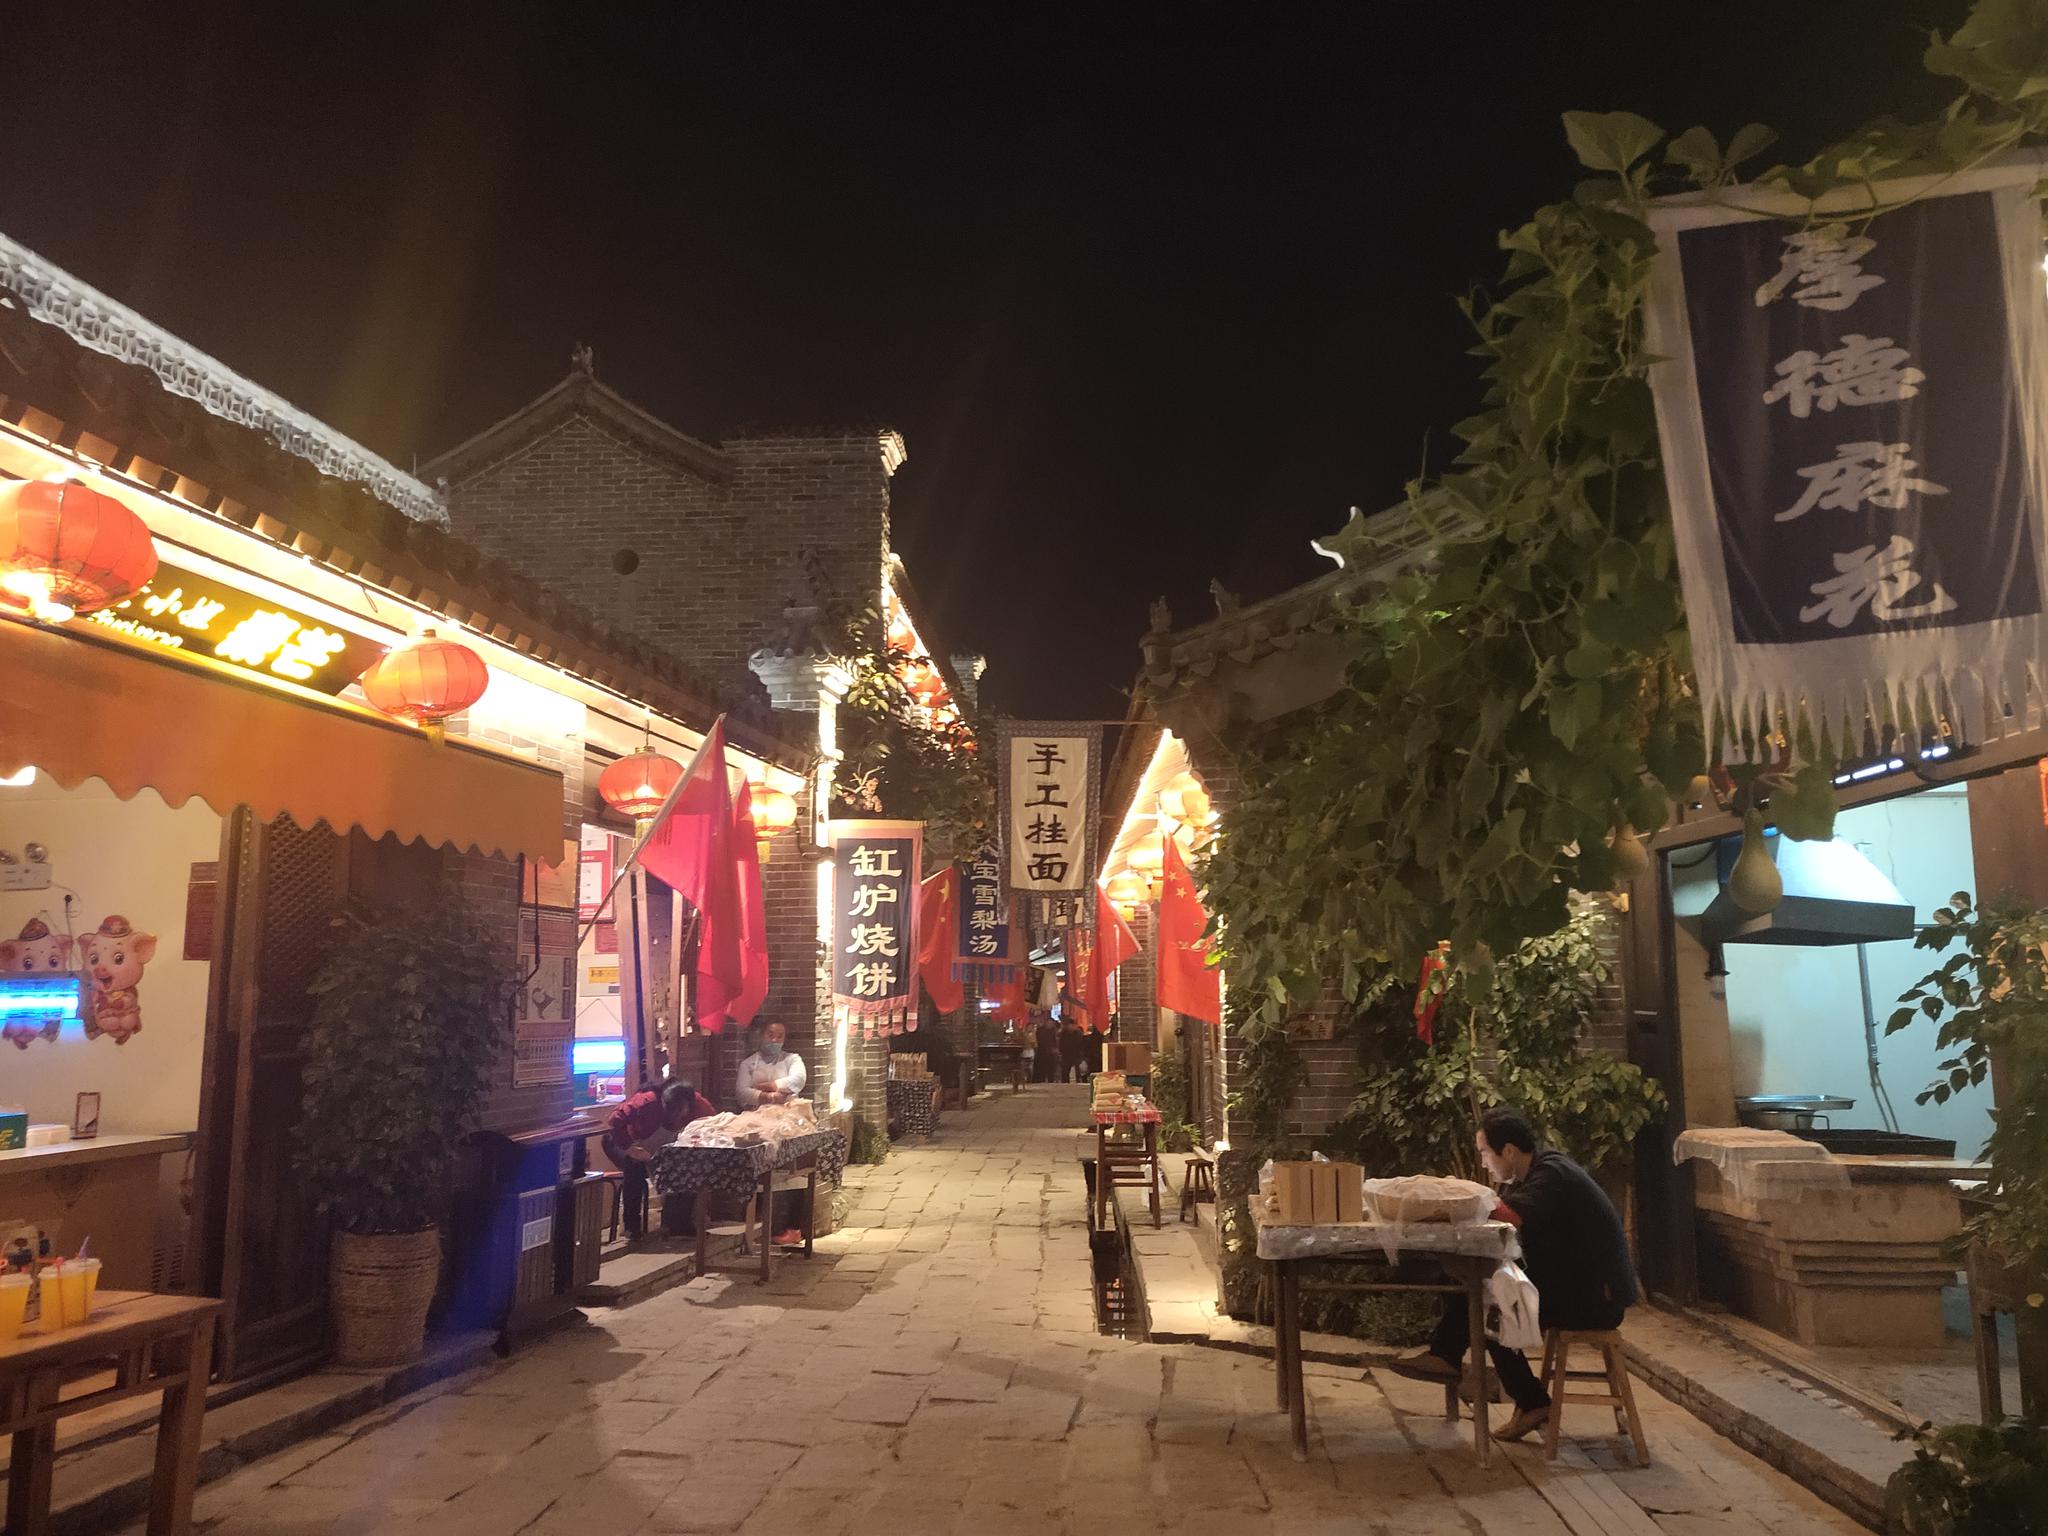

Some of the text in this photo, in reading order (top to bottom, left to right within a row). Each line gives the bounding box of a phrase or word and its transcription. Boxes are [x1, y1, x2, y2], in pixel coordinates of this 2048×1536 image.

[1755, 221, 1958, 628] 厚德麻花
[1024, 742, 1069, 883] 手工挂面
[845, 844, 903, 997] 缸炉烧饼
